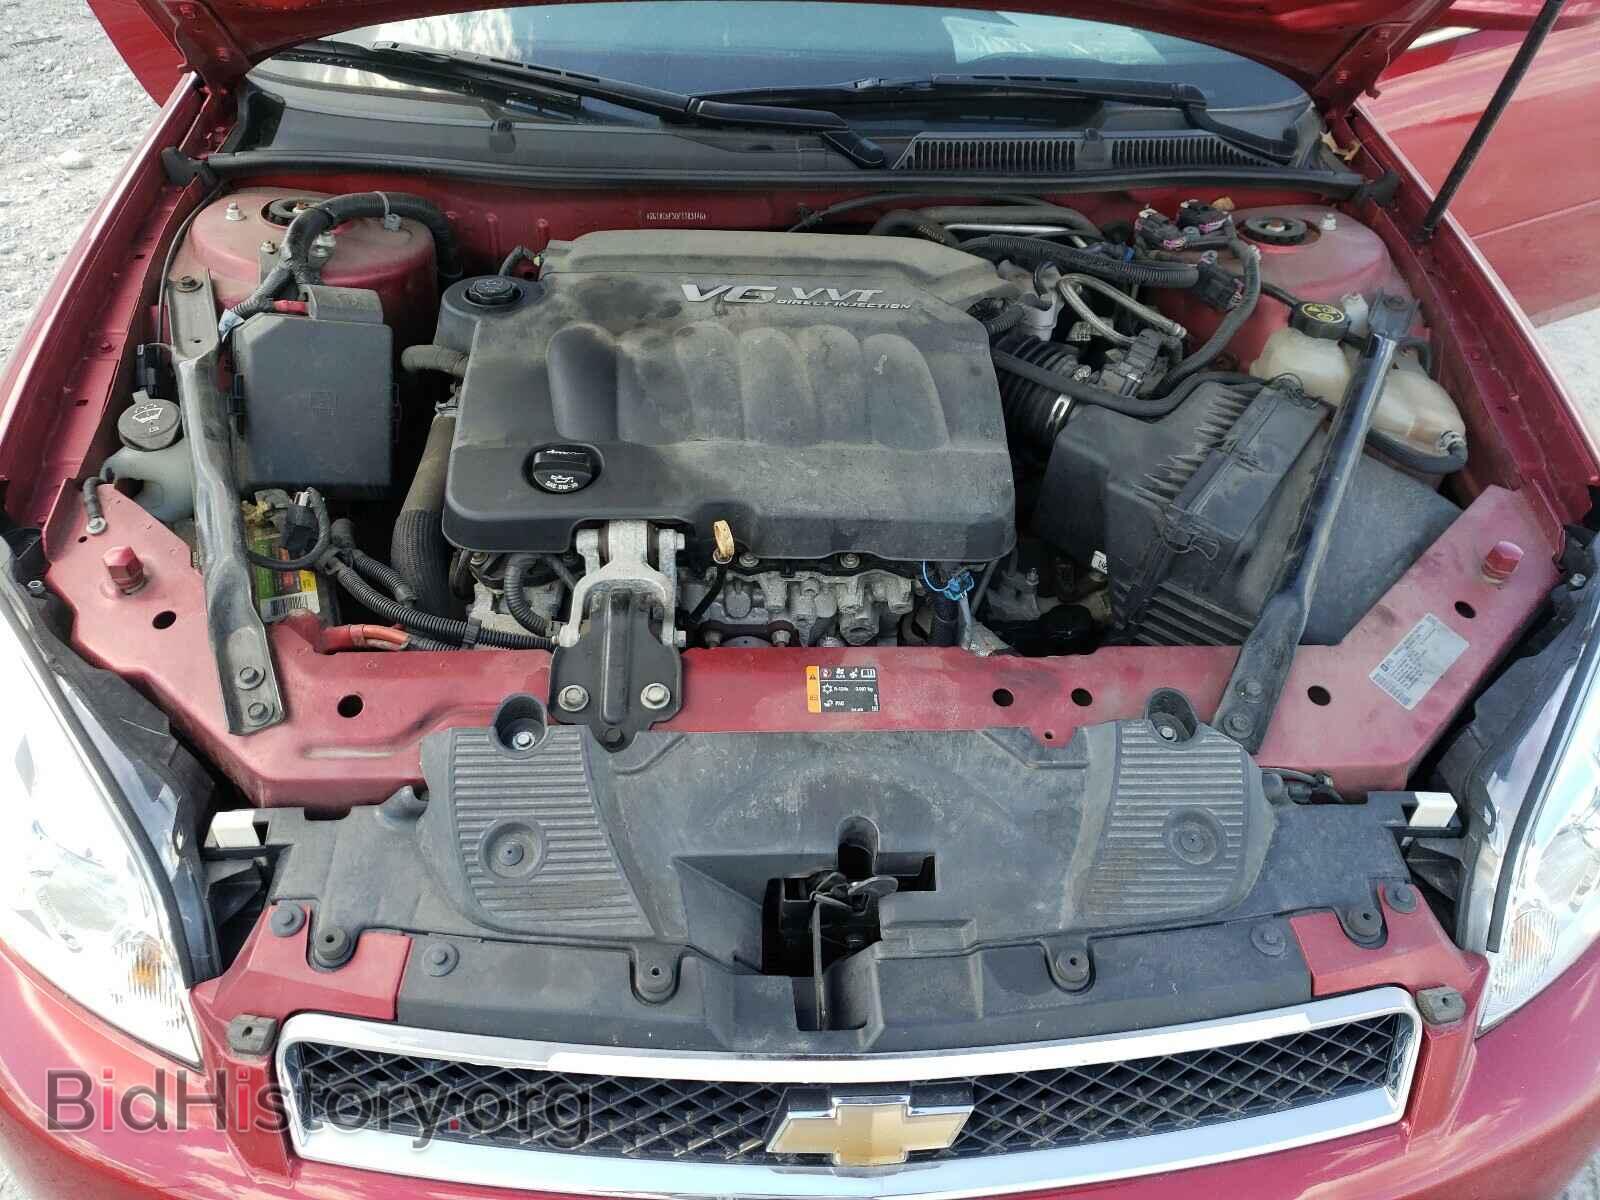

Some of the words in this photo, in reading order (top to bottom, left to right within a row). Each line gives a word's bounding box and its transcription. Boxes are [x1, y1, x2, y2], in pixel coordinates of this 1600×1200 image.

[681, 284, 777, 303] V6
[791, 287, 884, 302] VVT
[834, 301, 912, 309] INJECTION
